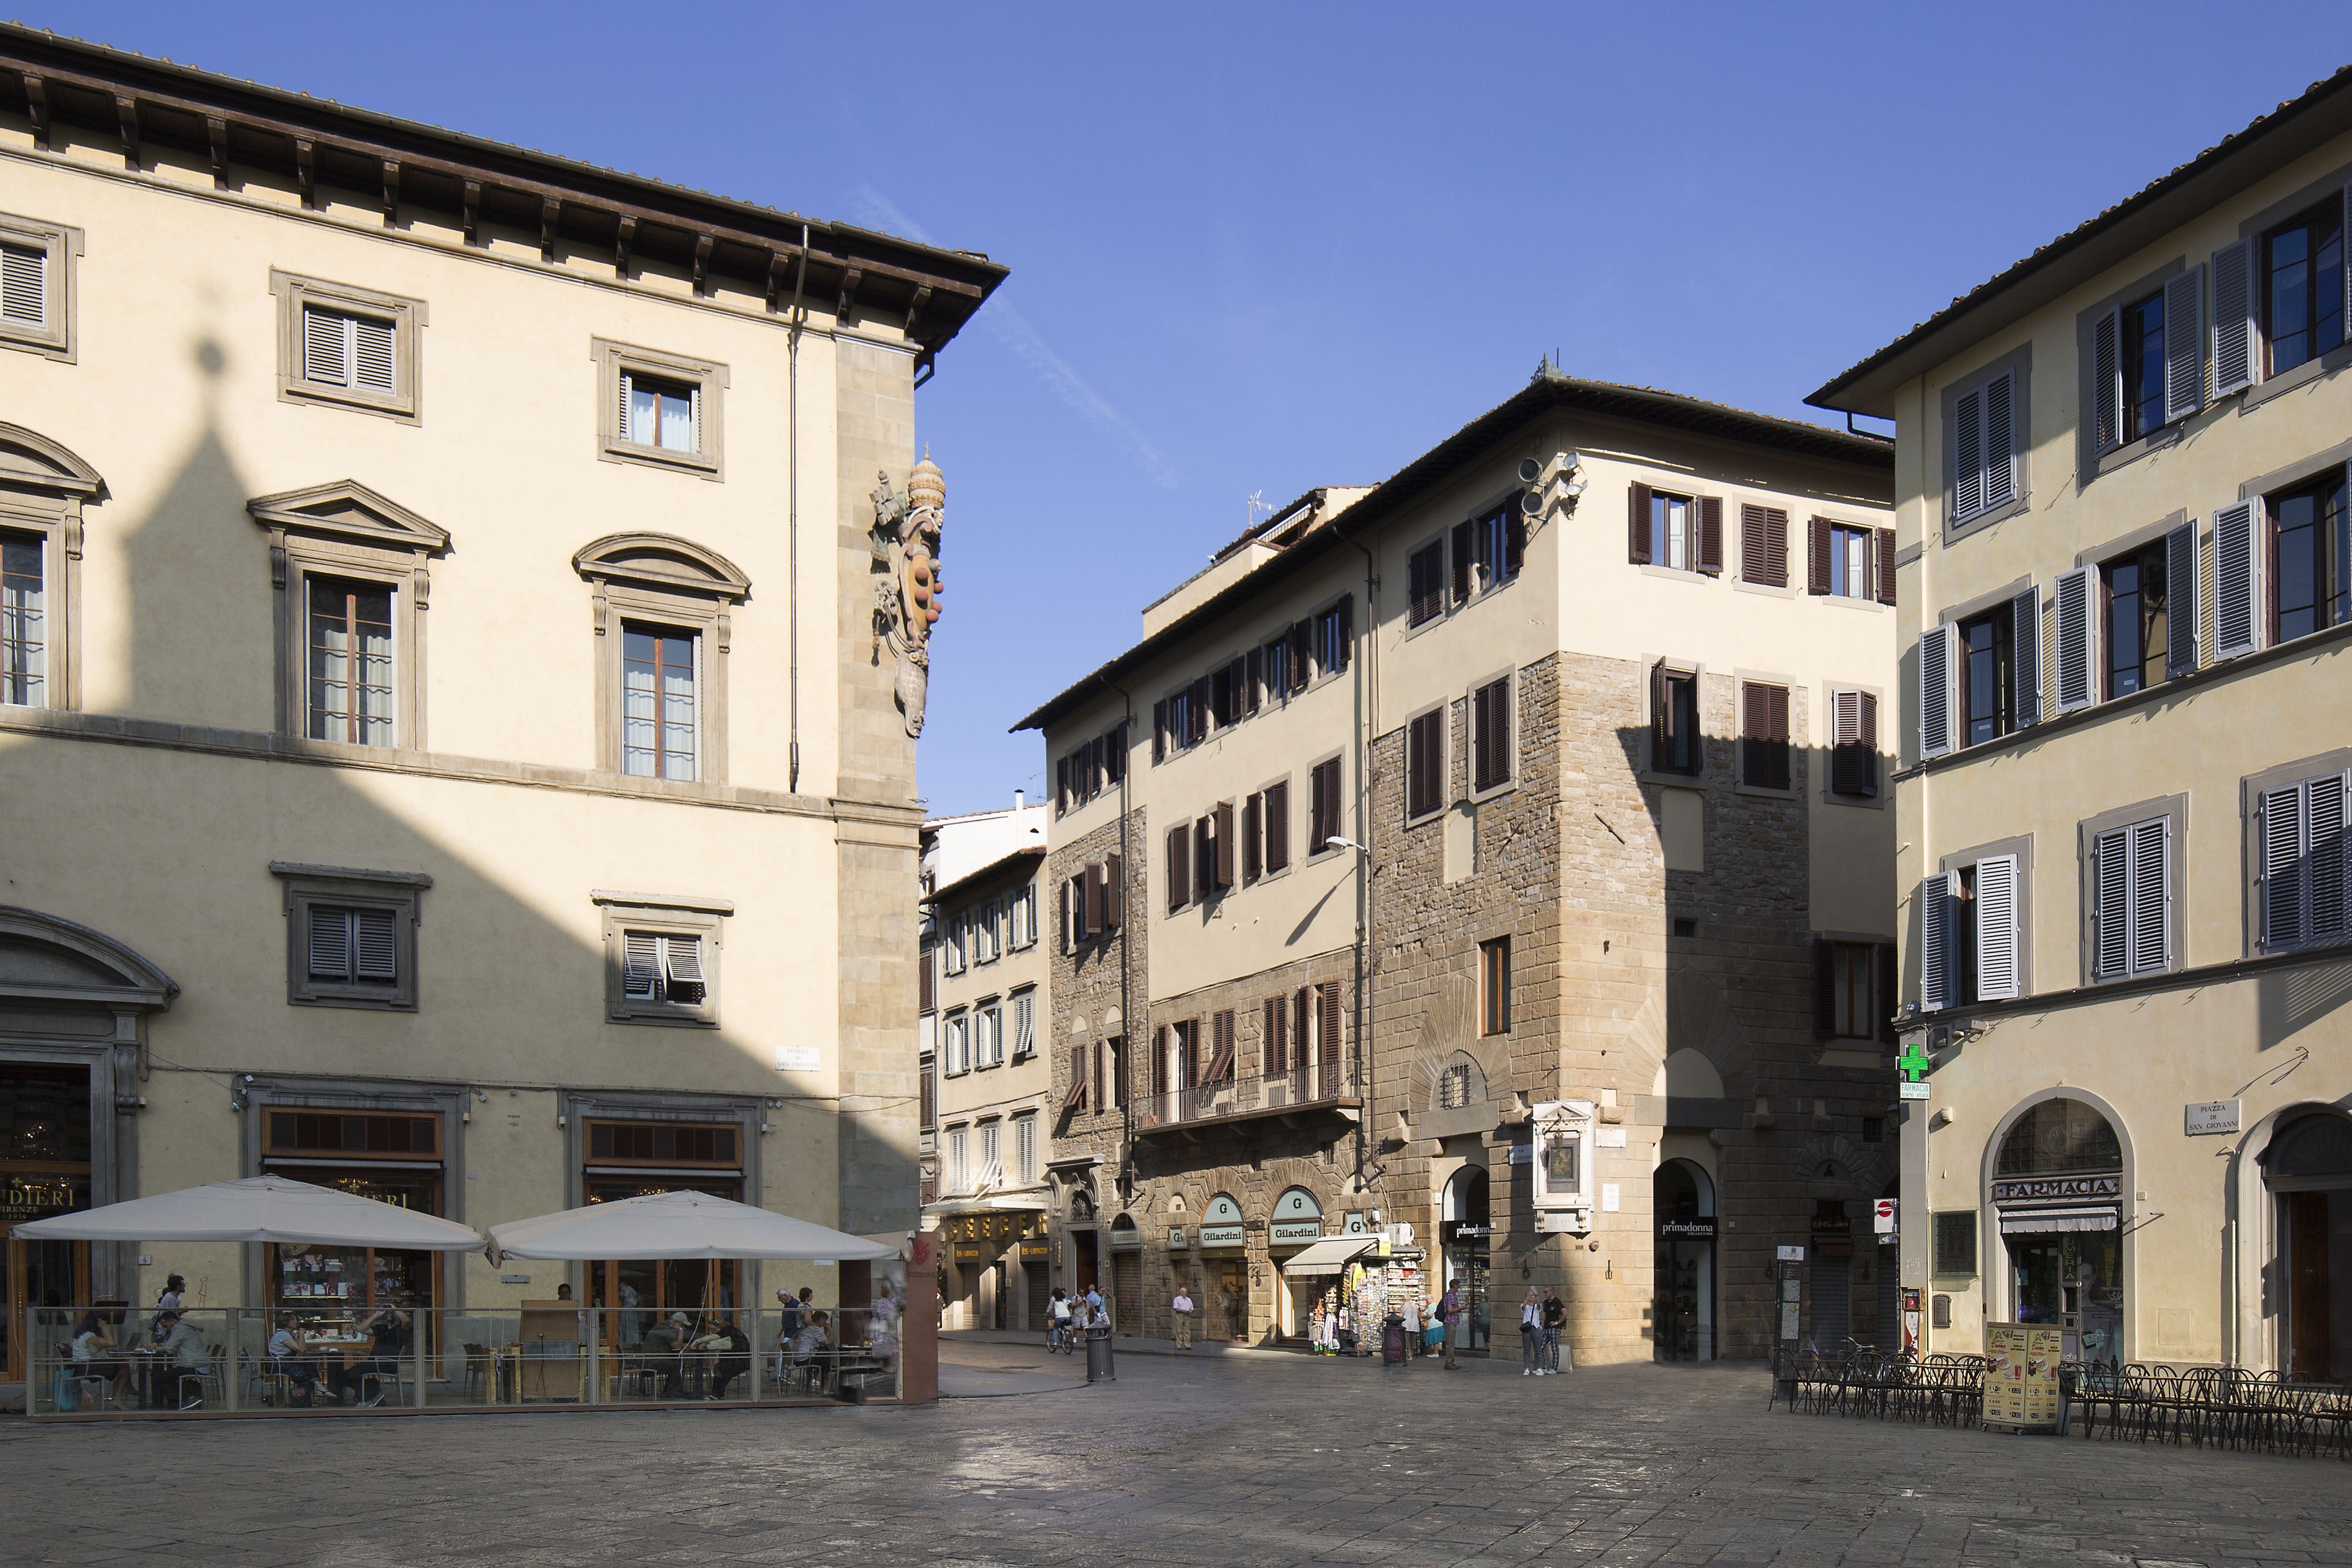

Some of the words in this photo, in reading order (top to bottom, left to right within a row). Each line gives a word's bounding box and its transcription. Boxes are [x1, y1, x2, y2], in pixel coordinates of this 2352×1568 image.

[1902, 1084, 1929, 1092] FARMACIA
[2004, 1178, 2112, 1197] FARMACIA
[1219, 1204, 1227, 1213] G
[1293, 1198, 1302, 1209] G
[1351, 1221, 1361, 1232] G
[1457, 1223, 1490, 1238] primadonn
[1662, 1220, 1713, 1235] primadonna
[1174, 1233, 1180, 1242] G
[1204, 1232, 1242, 1241] Gilardini
[1276, 1228, 1317, 1238] Gilardini
